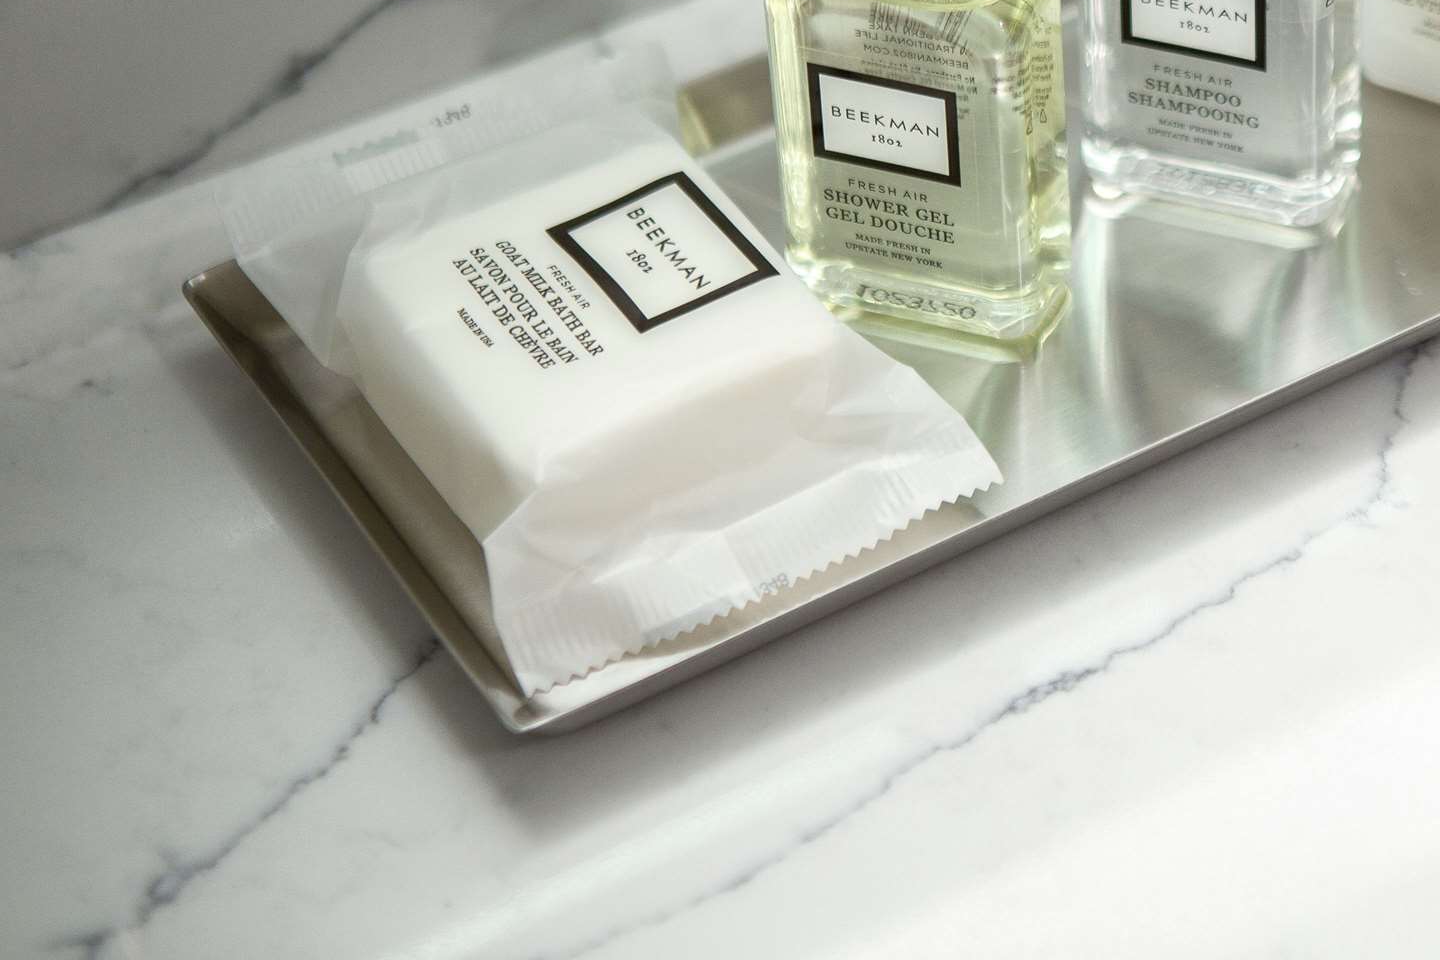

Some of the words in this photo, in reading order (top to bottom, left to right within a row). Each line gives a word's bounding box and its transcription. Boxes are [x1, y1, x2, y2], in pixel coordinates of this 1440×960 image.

[1180, 20, 1211, 35] 1802
[1152, 64, 1202, 82] FRESH
[1208, 76, 1233, 88] AIR
[1145, 78, 1241, 107] SHAMPOO
[831, 105, 940, 137] BEEKMAN
[1128, 91, 1259, 128] SHAMPOOING
[872, 134, 903, 148] 1802
[848, 178, 897, 196] FRESH
[903, 190, 928, 203] AIR
[824, 188, 910, 217] SHOWER
[916, 208, 955, 227] GEL
[826, 206, 865, 225] GEL
[871, 215, 955, 244] DOUCHE
[626, 207, 712, 290] BEEKMAN
[845, 241, 889, 258] UPSTATE
[891, 251, 913, 263] NEW
[915, 257, 943, 269] YORK
[855, 233, 883, 246] MADE
[886, 240, 918, 253] FRESH
[921, 247, 931, 256] IN
[626, 248, 655, 274] 1802
[495, 240, 530, 267] GOAT
[521, 266, 556, 298] MILK
[547, 296, 584, 332] BATH
[575, 329, 604, 356] BAR
[546, 265, 576, 293] FRESH
[572, 294, 590, 310] AIR
[452, 259, 477, 276] AU
[467, 274, 501, 306] LAIT
[492, 304, 515, 326] DE
[509, 325, 556, 369] CHÈVRE
[470, 247, 511, 286] SAVON
[503, 284, 538, 322] POUR
[531, 320, 554, 339] LE
[545, 337, 579, 363] BAIN
